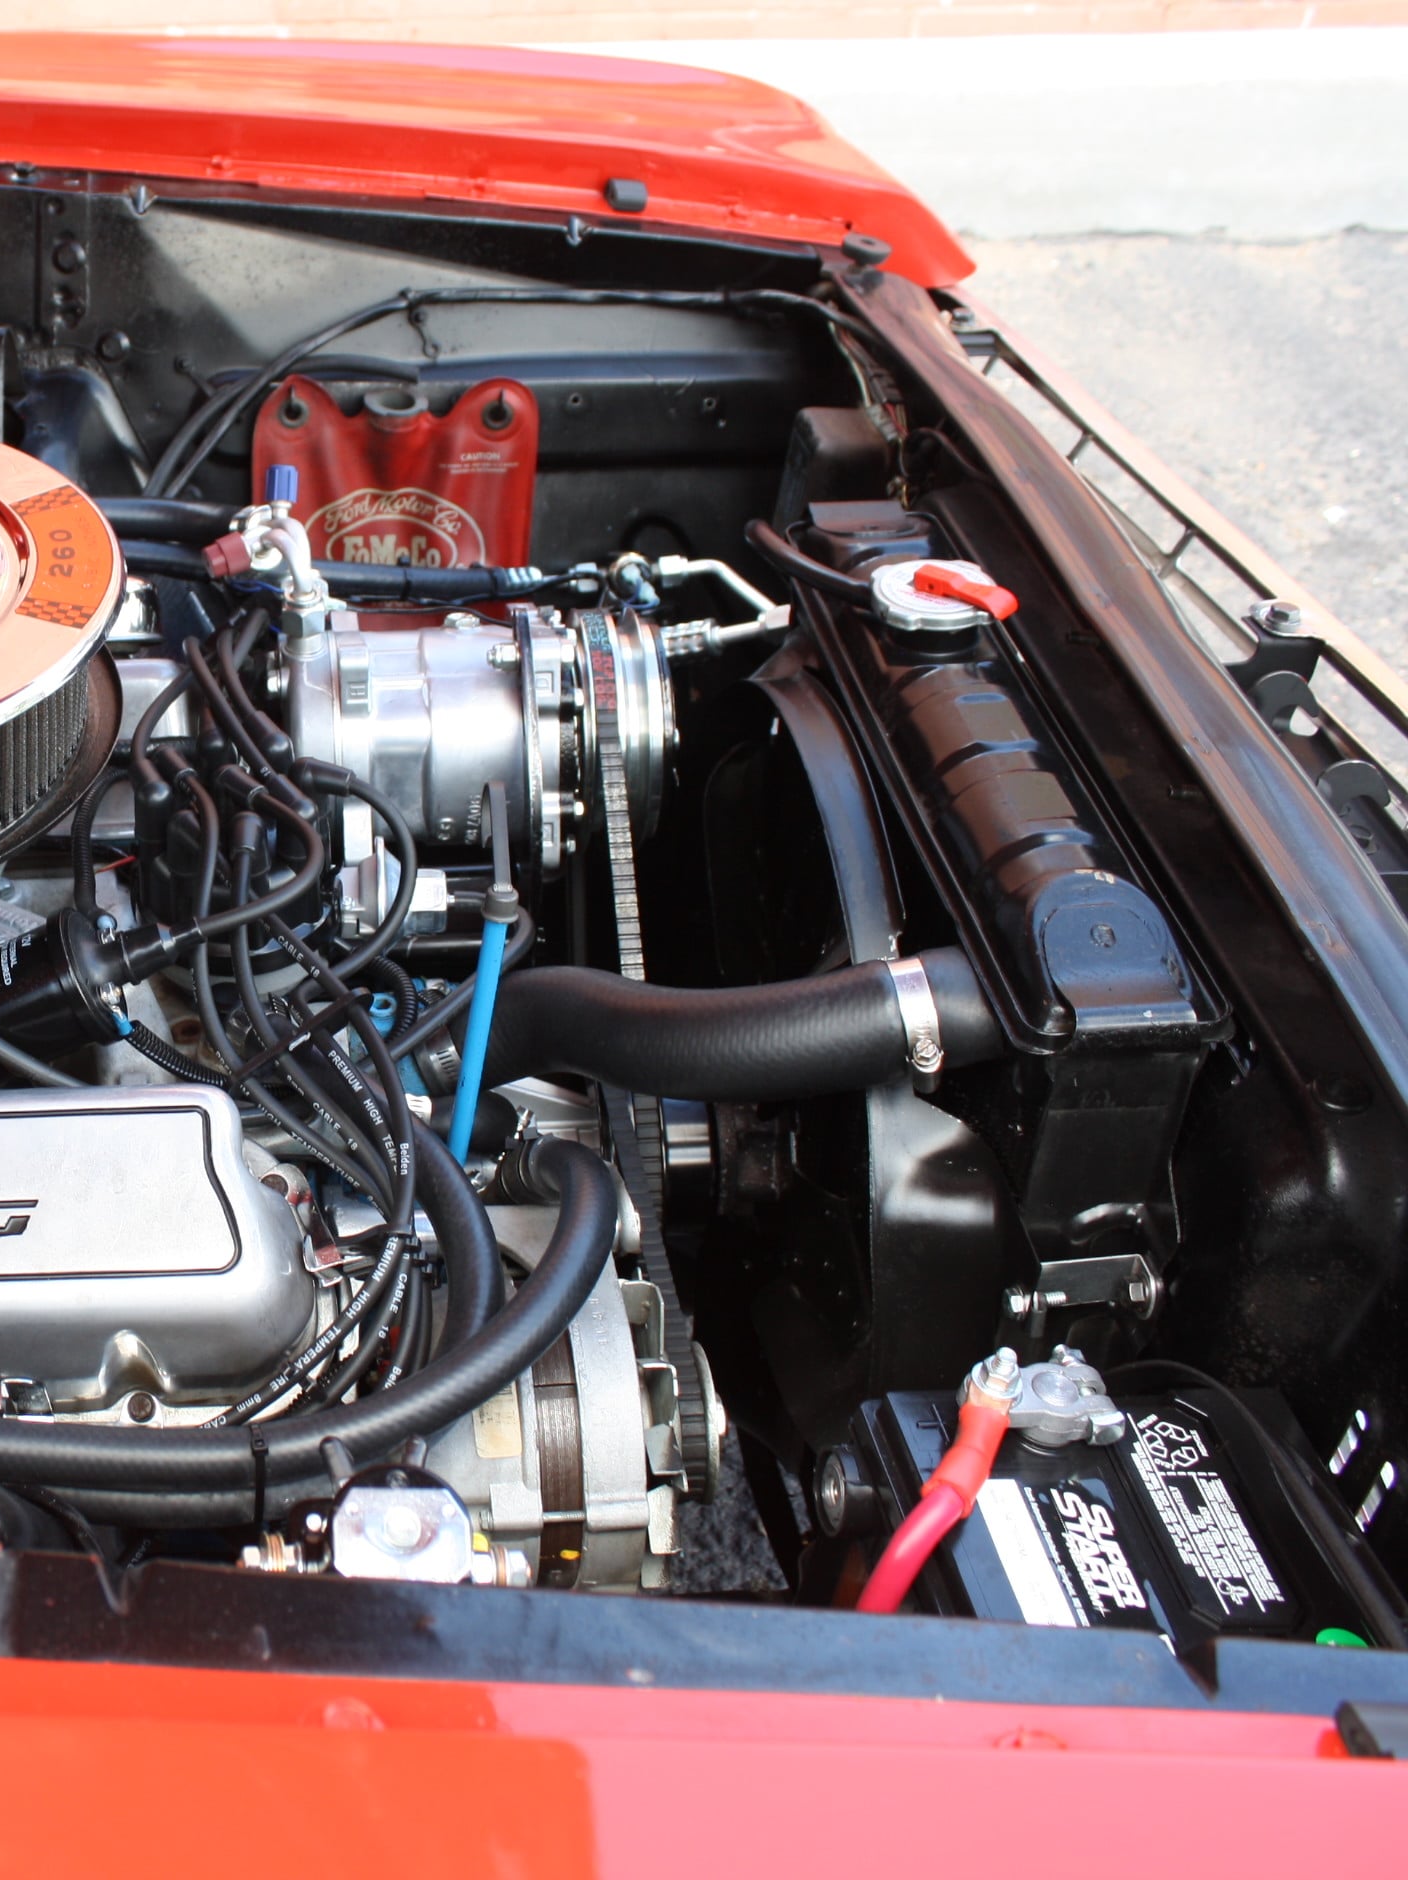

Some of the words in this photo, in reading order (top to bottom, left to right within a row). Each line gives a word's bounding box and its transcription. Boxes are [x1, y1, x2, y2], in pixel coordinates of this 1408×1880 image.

[324, 494, 370, 533] Ford
[369, 492, 438, 516] Motor
[49, 529, 75, 577] 260
[277, 935, 303, 962] CABLE
[309, 965, 321, 978] 18
[328, 1050, 364, 1093] PREMIUM
[363, 1098, 384, 1126] HIGH
[312, 1102, 342, 1131] CABLE
[347, 1137, 359, 1151] 18
[291, 1132, 361, 1189] TEMPERATURE
[399, 1142, 409, 1176] Belden
[345, 1289, 371, 1320] HIGH
[388, 1273, 408, 1315] CABLE
[378, 1324, 390, 1340] 18
[236, 1393, 263, 1414] 8mm
[1050, 1488, 1126, 1608] START
[1090, 1504, 1146, 1608] SUPER
